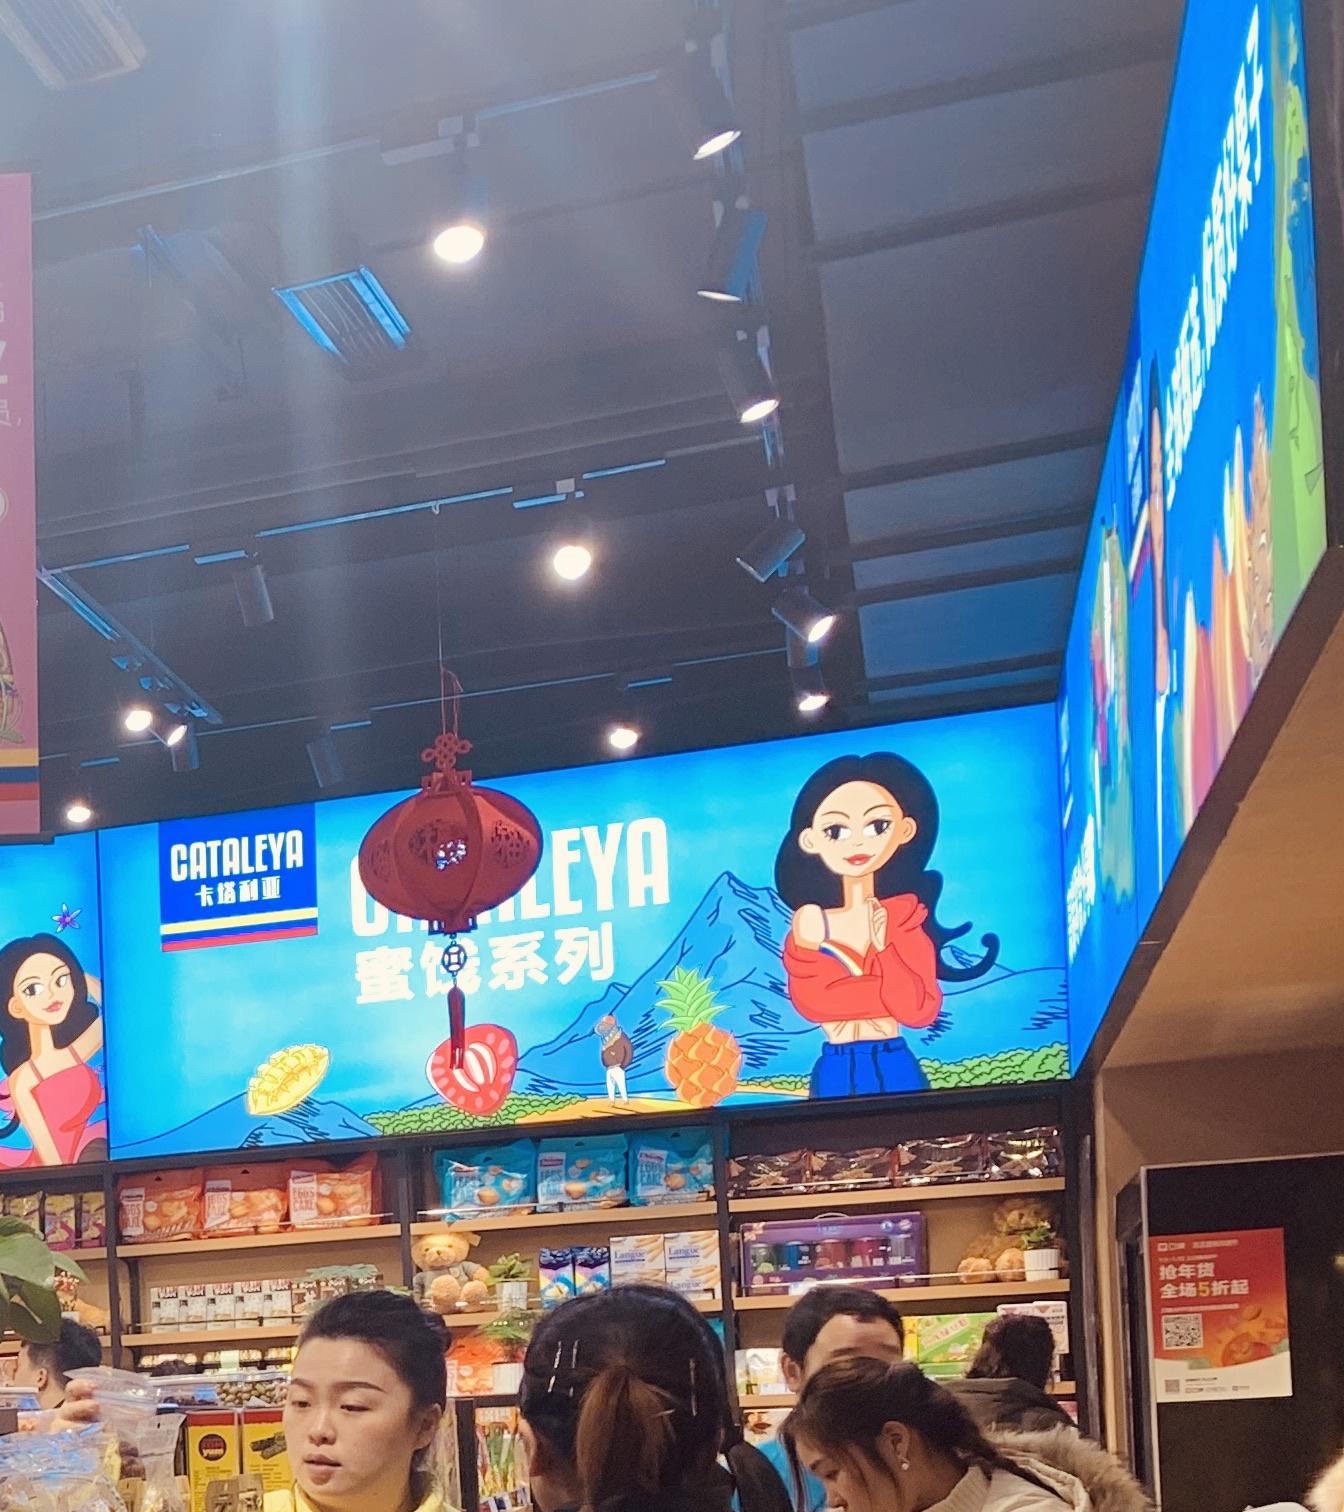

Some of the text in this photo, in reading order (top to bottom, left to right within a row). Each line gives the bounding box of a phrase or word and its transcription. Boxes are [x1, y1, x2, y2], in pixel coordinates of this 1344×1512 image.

[170, 828, 305, 883] CATALEYA
[195, 875, 282, 907] 卡塔利亚
[1160, 1279, 1249, 1299] 全场5折起
